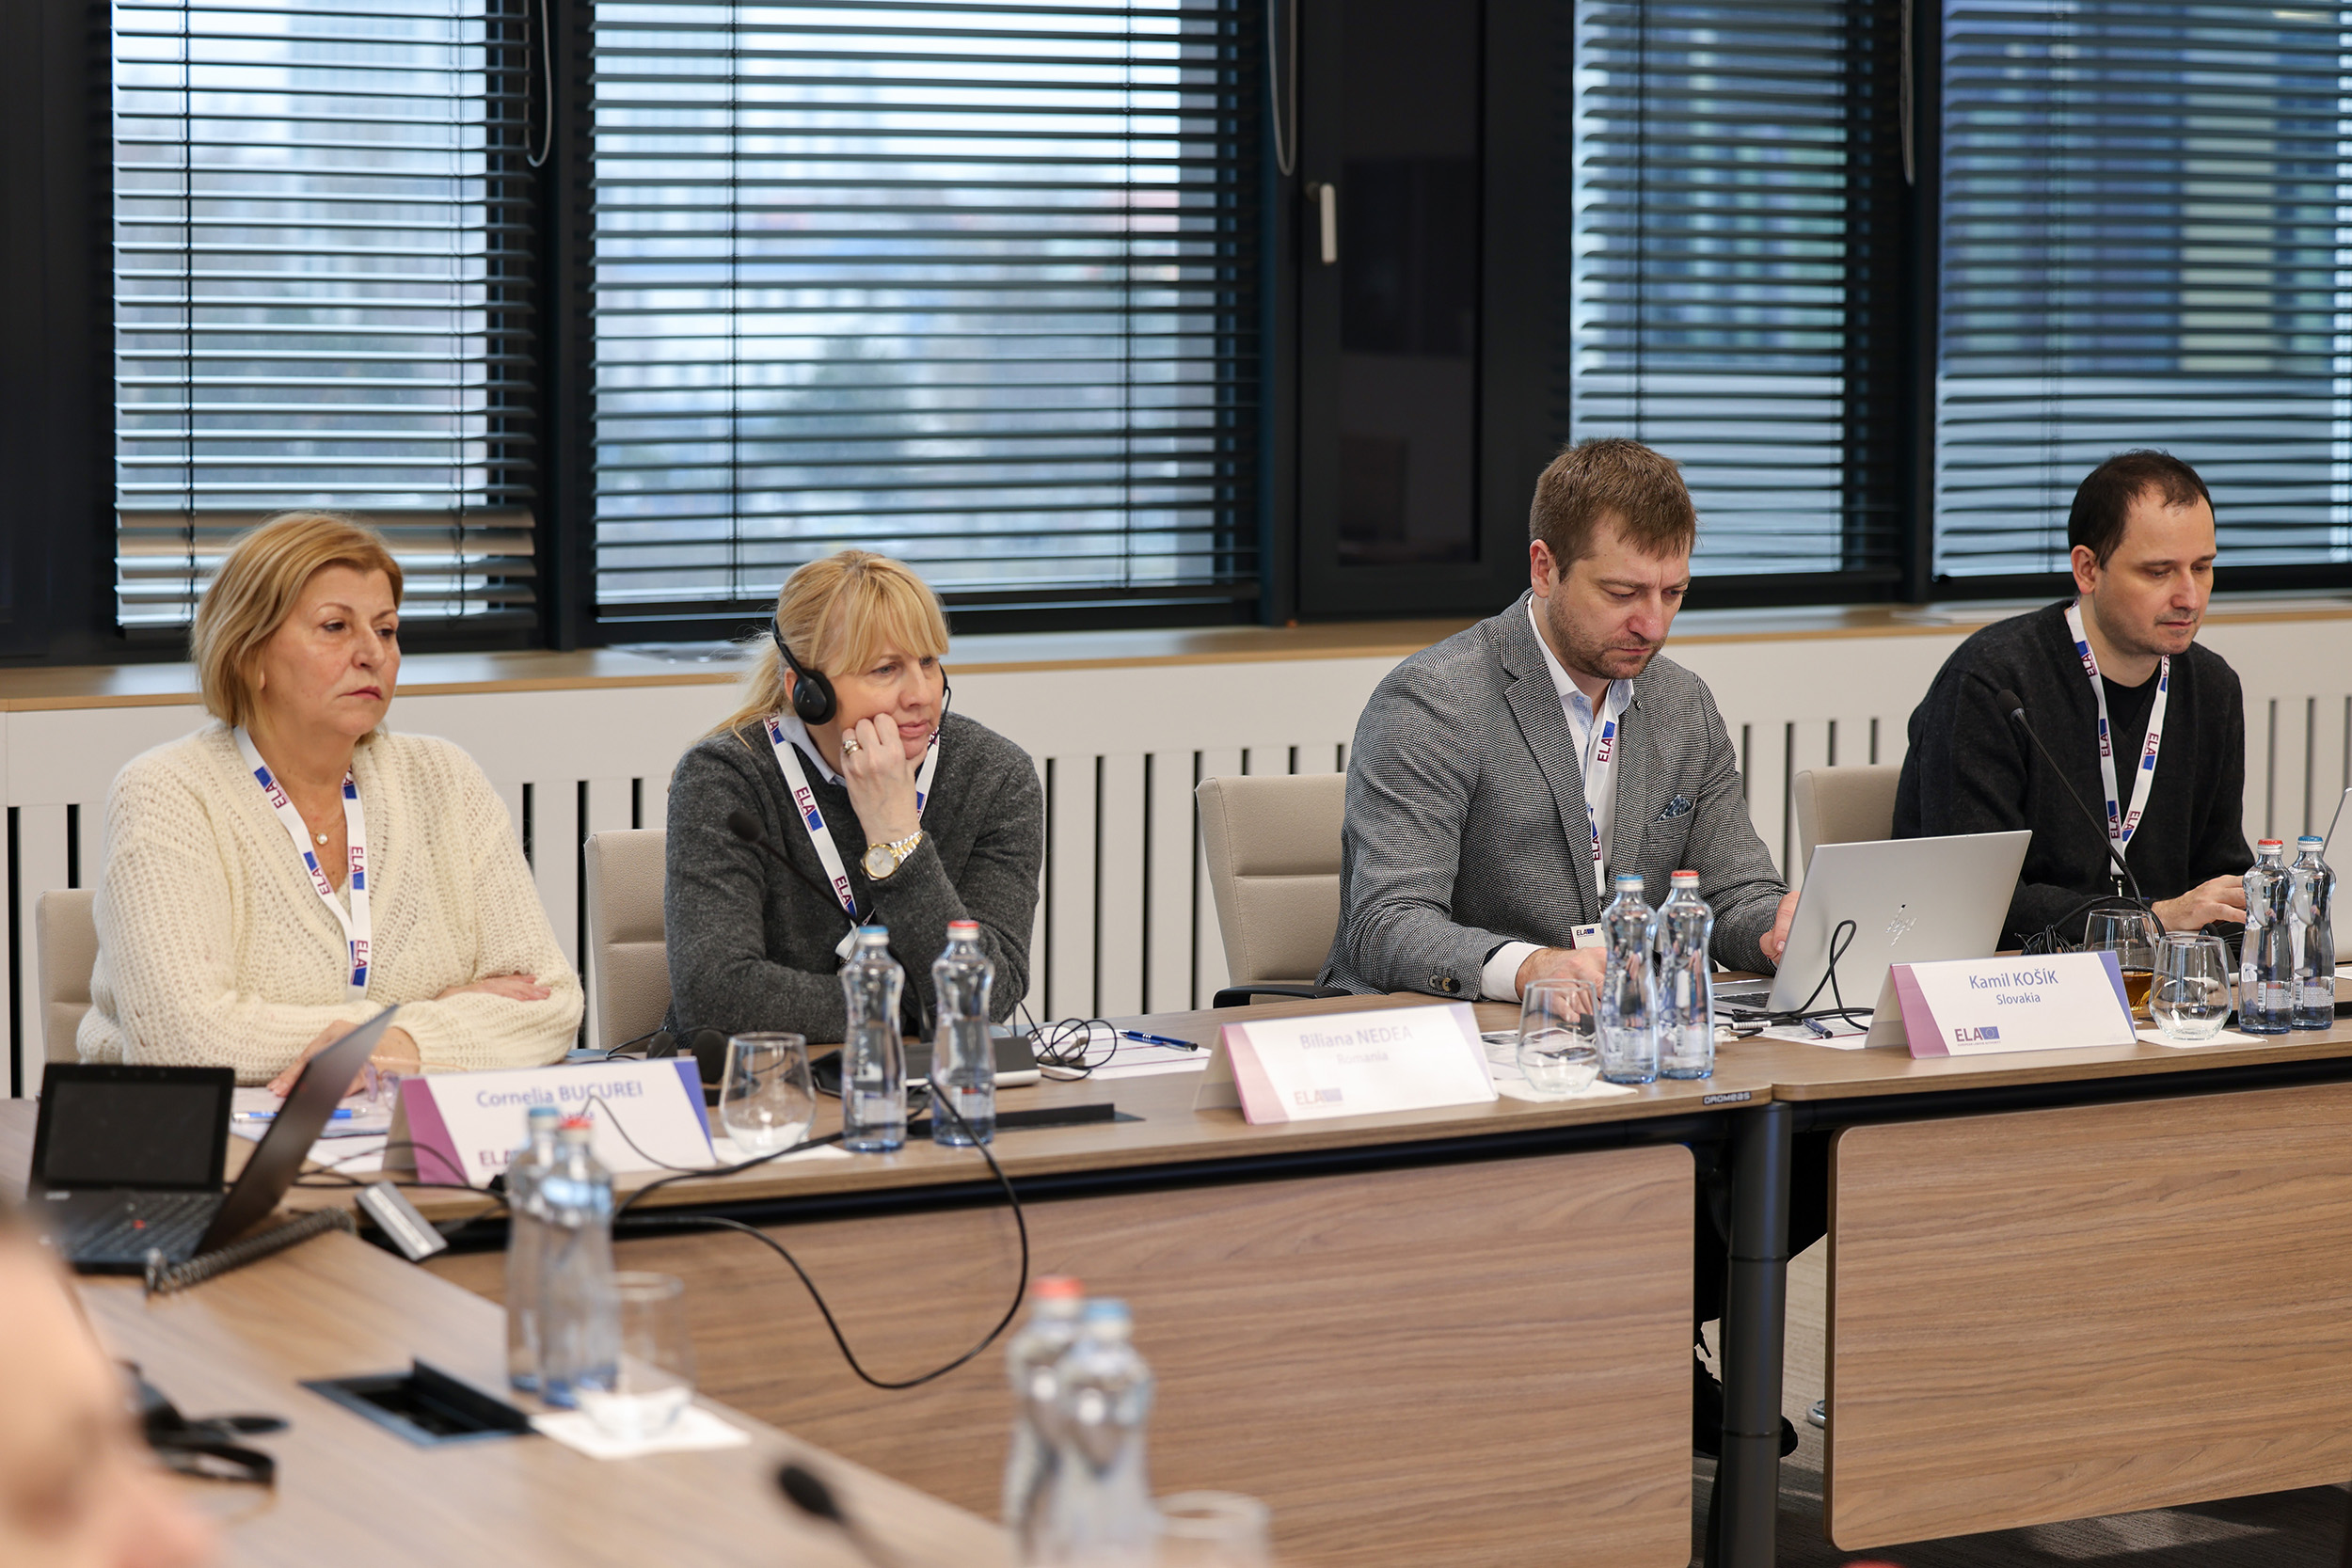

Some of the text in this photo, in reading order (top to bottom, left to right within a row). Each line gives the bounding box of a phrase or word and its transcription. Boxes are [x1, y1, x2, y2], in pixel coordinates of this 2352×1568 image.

[2081, 653, 2097, 677] ELA
[1597, 737, 1613, 763] ELA
[2101, 733, 2111, 757] ELA
[2145, 732, 2159, 756] ELA
[265, 780, 287, 809] ELA
[796, 786, 817, 816] ELA
[2109, 815, 2119, 839] ELA
[2123, 810, 2140, 831] ELA
[351, 847, 364, 873] ELA
[312, 868, 330, 895] ELA
[834, 876, 852, 905] ELA
[356, 941, 369, 968] ELA
[1969, 968, 2058, 990] Kamil KOŠÍK
[1995, 992, 2041, 1005] Slovakia
[1299, 1025, 1413, 1050] Biliana NEDEA
[1954, 1027, 1983, 1042] ELA
[1336, 1050, 1389, 1065] Romania
[476, 1081, 644, 1107] Cornelia BUCUREI
[1294, 1088, 1325, 1105] ELA
